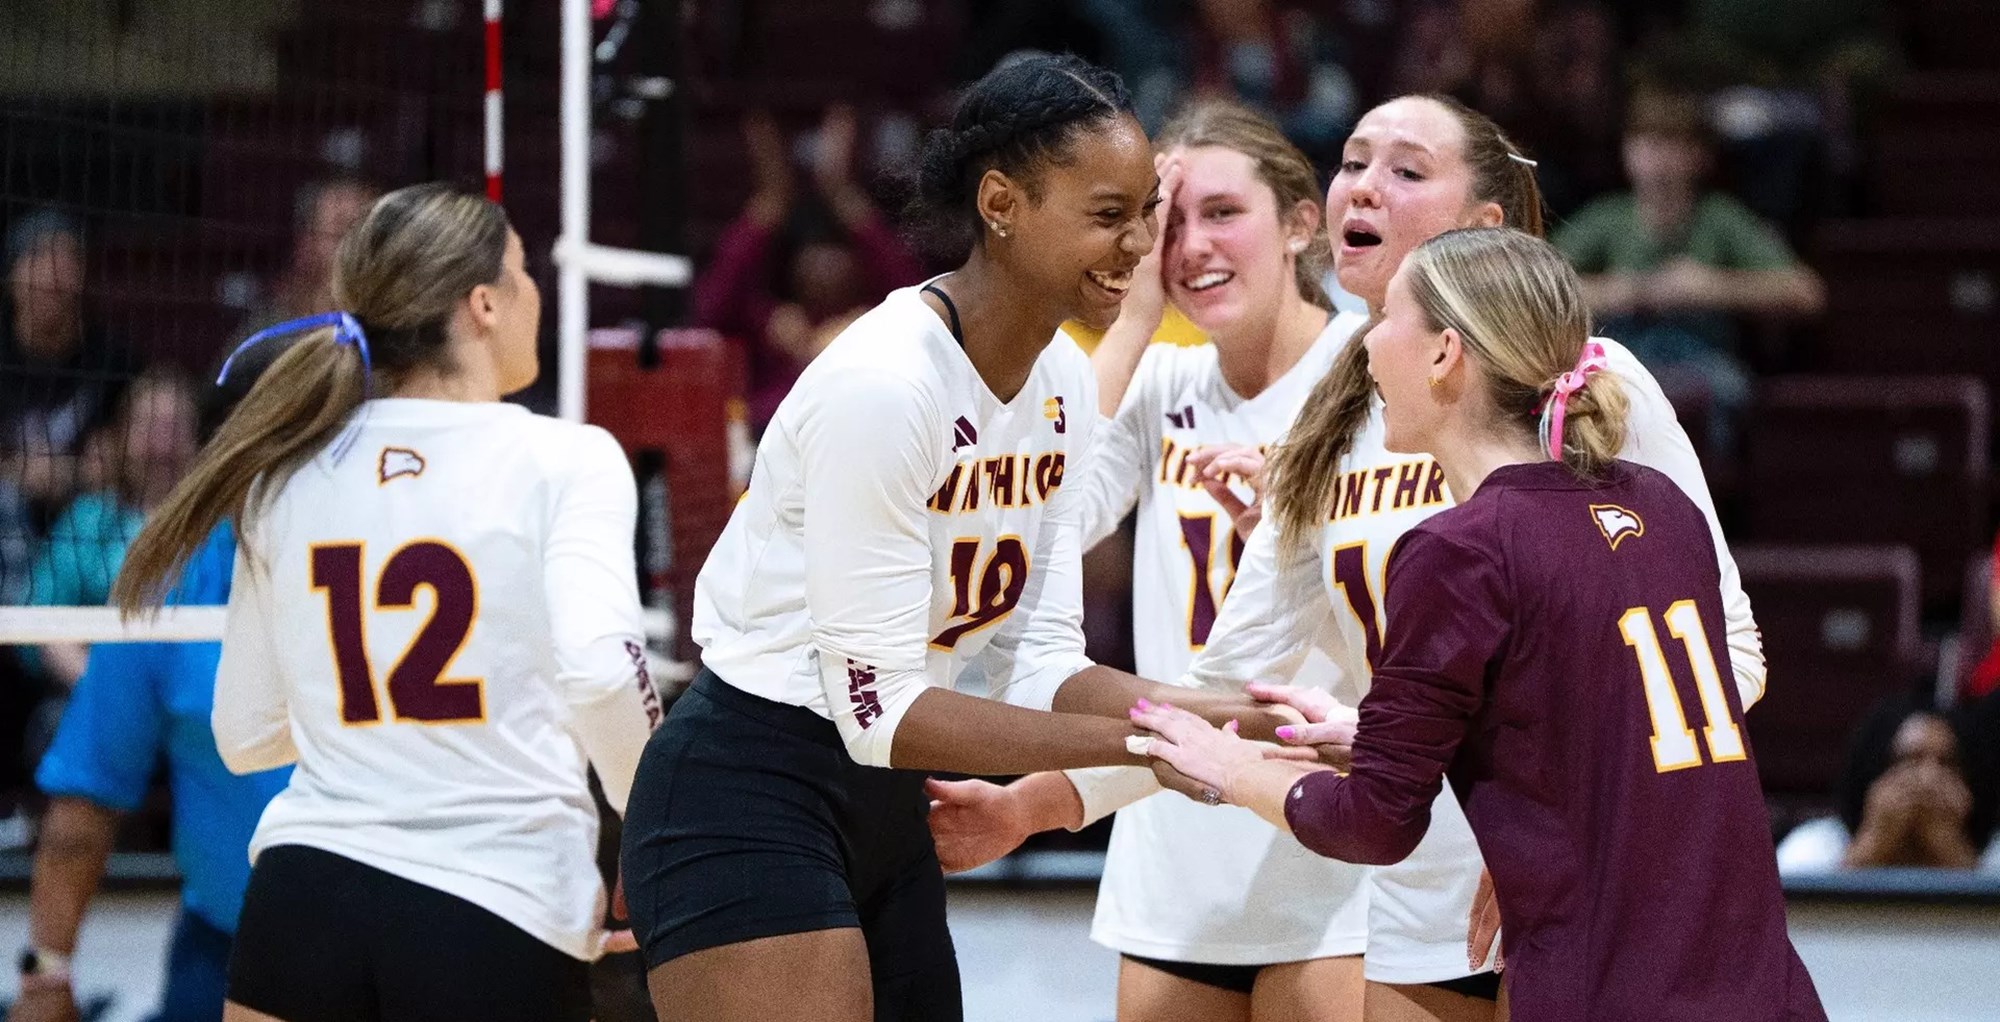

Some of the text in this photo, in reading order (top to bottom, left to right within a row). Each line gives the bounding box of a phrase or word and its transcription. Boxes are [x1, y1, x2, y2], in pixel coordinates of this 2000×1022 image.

[308, 537, 488, 729] 12
[1332, 540, 1393, 676] 1
[1617, 599, 1747, 773] 11
